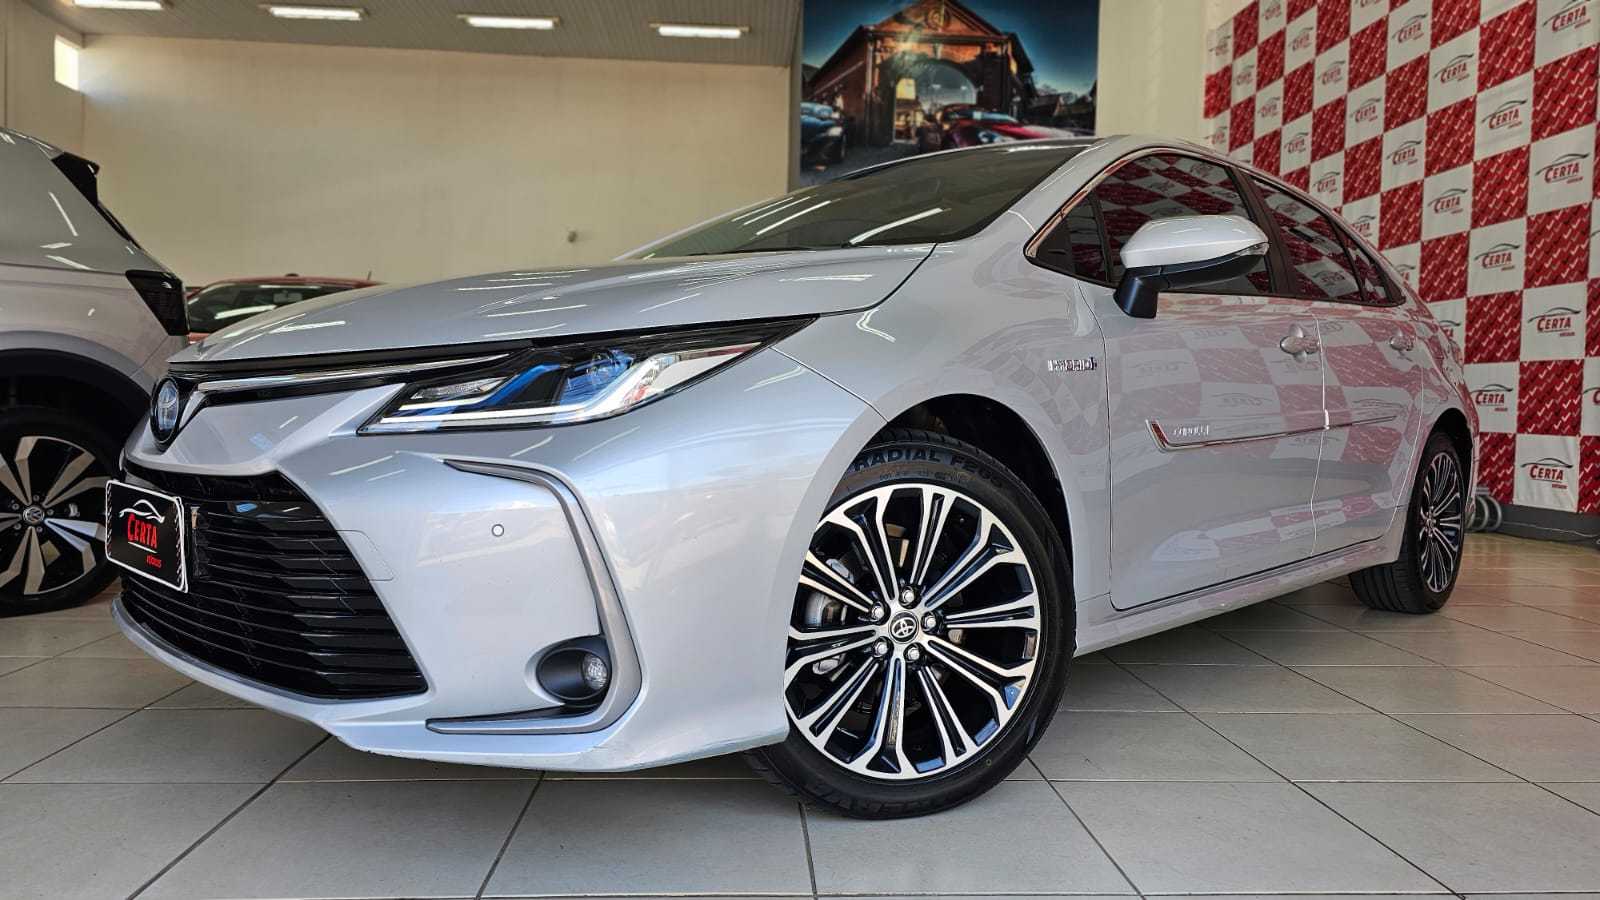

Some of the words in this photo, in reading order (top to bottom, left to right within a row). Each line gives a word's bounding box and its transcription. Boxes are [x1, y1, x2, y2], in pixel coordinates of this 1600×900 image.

[1552, 6, 1586, 32] CERTA
[1441, 62, 1467, 83] CERTA
[1489, 109, 1519, 129] CERTA
[1544, 162, 1580, 183] CERTA
[1434, 196, 1460, 213] CERTA
[1482, 252, 1512, 269] CERTA
[1537, 317, 1571, 331] CERTA
[1475, 392, 1505, 405] CERTA
[853, 449, 940, 473] RADIAL
[1530, 465, 1564, 480] CERTA
[128, 513, 157, 549] CERTA
